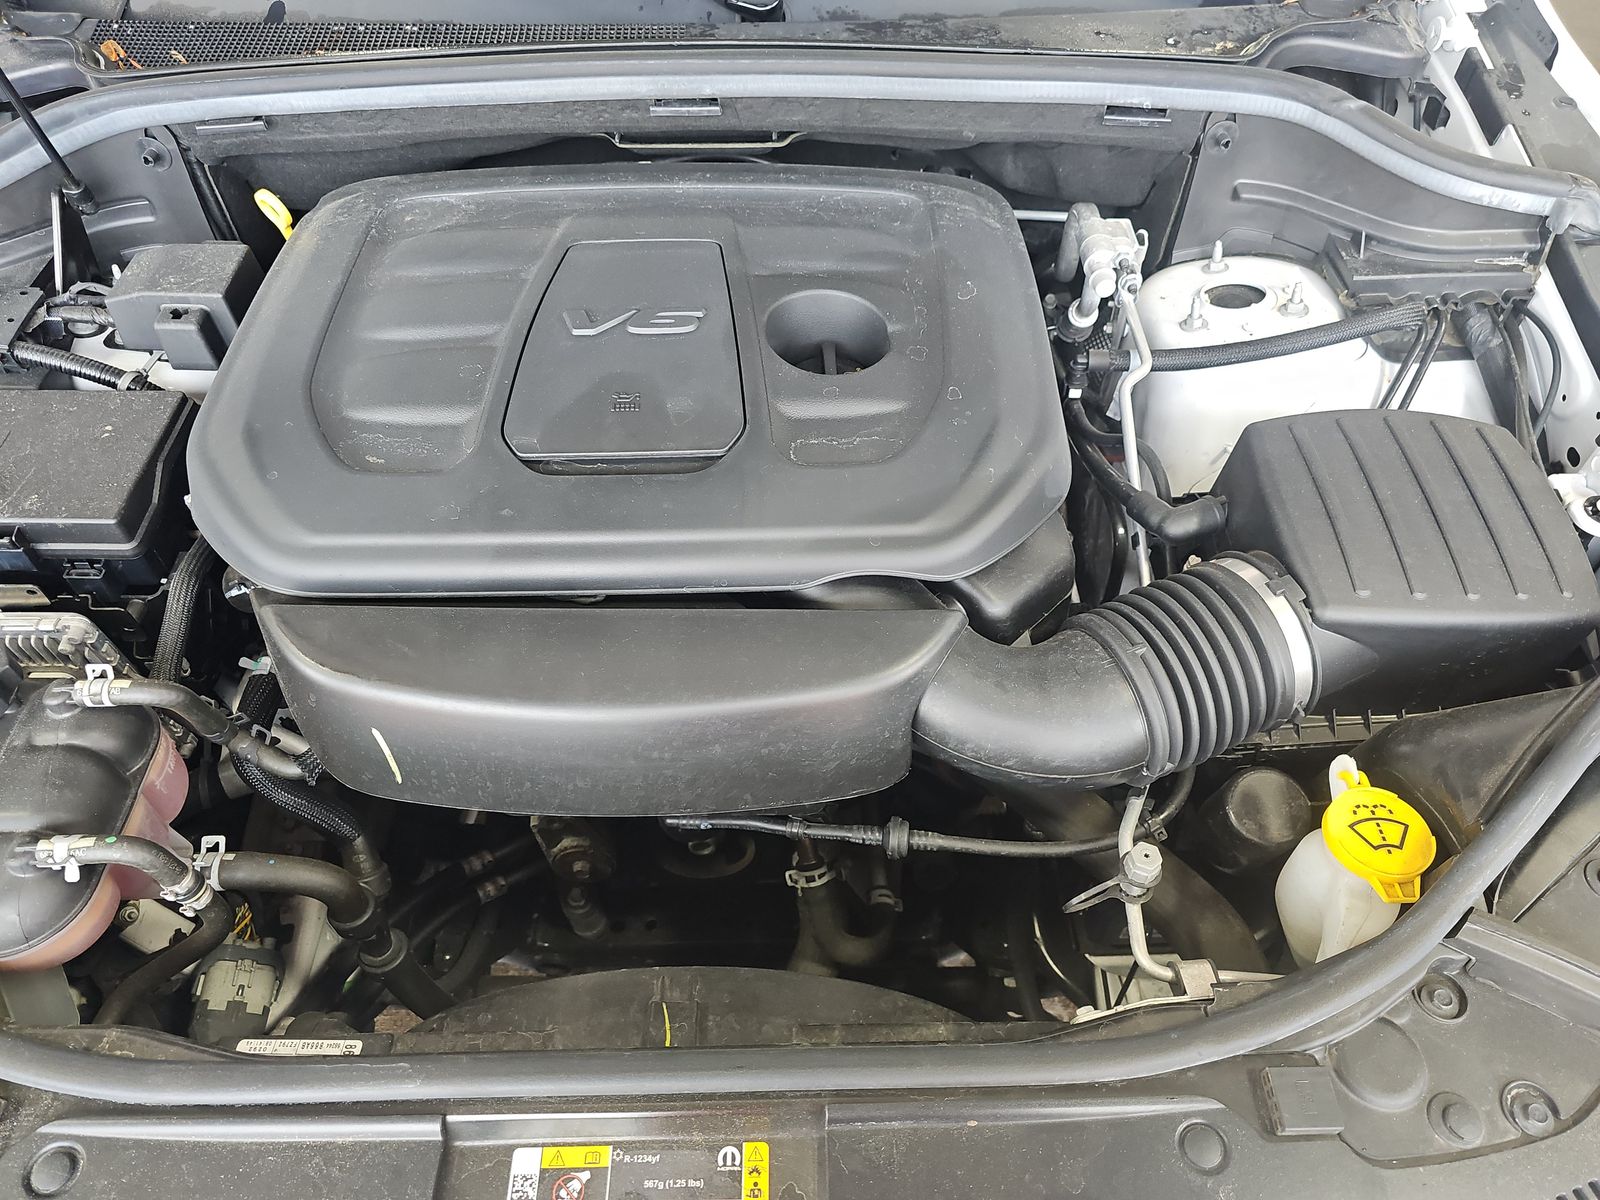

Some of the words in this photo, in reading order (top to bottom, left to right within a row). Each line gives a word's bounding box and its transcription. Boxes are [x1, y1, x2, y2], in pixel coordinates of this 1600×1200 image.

[562, 308, 708, 336] V6
[624, 1154, 661, 1164] R-1234yf
[643, 1180, 664, 1190] 567g
[665, 1179, 687, 1190] (1.25
[687, 1178, 705, 1189] lbs)
